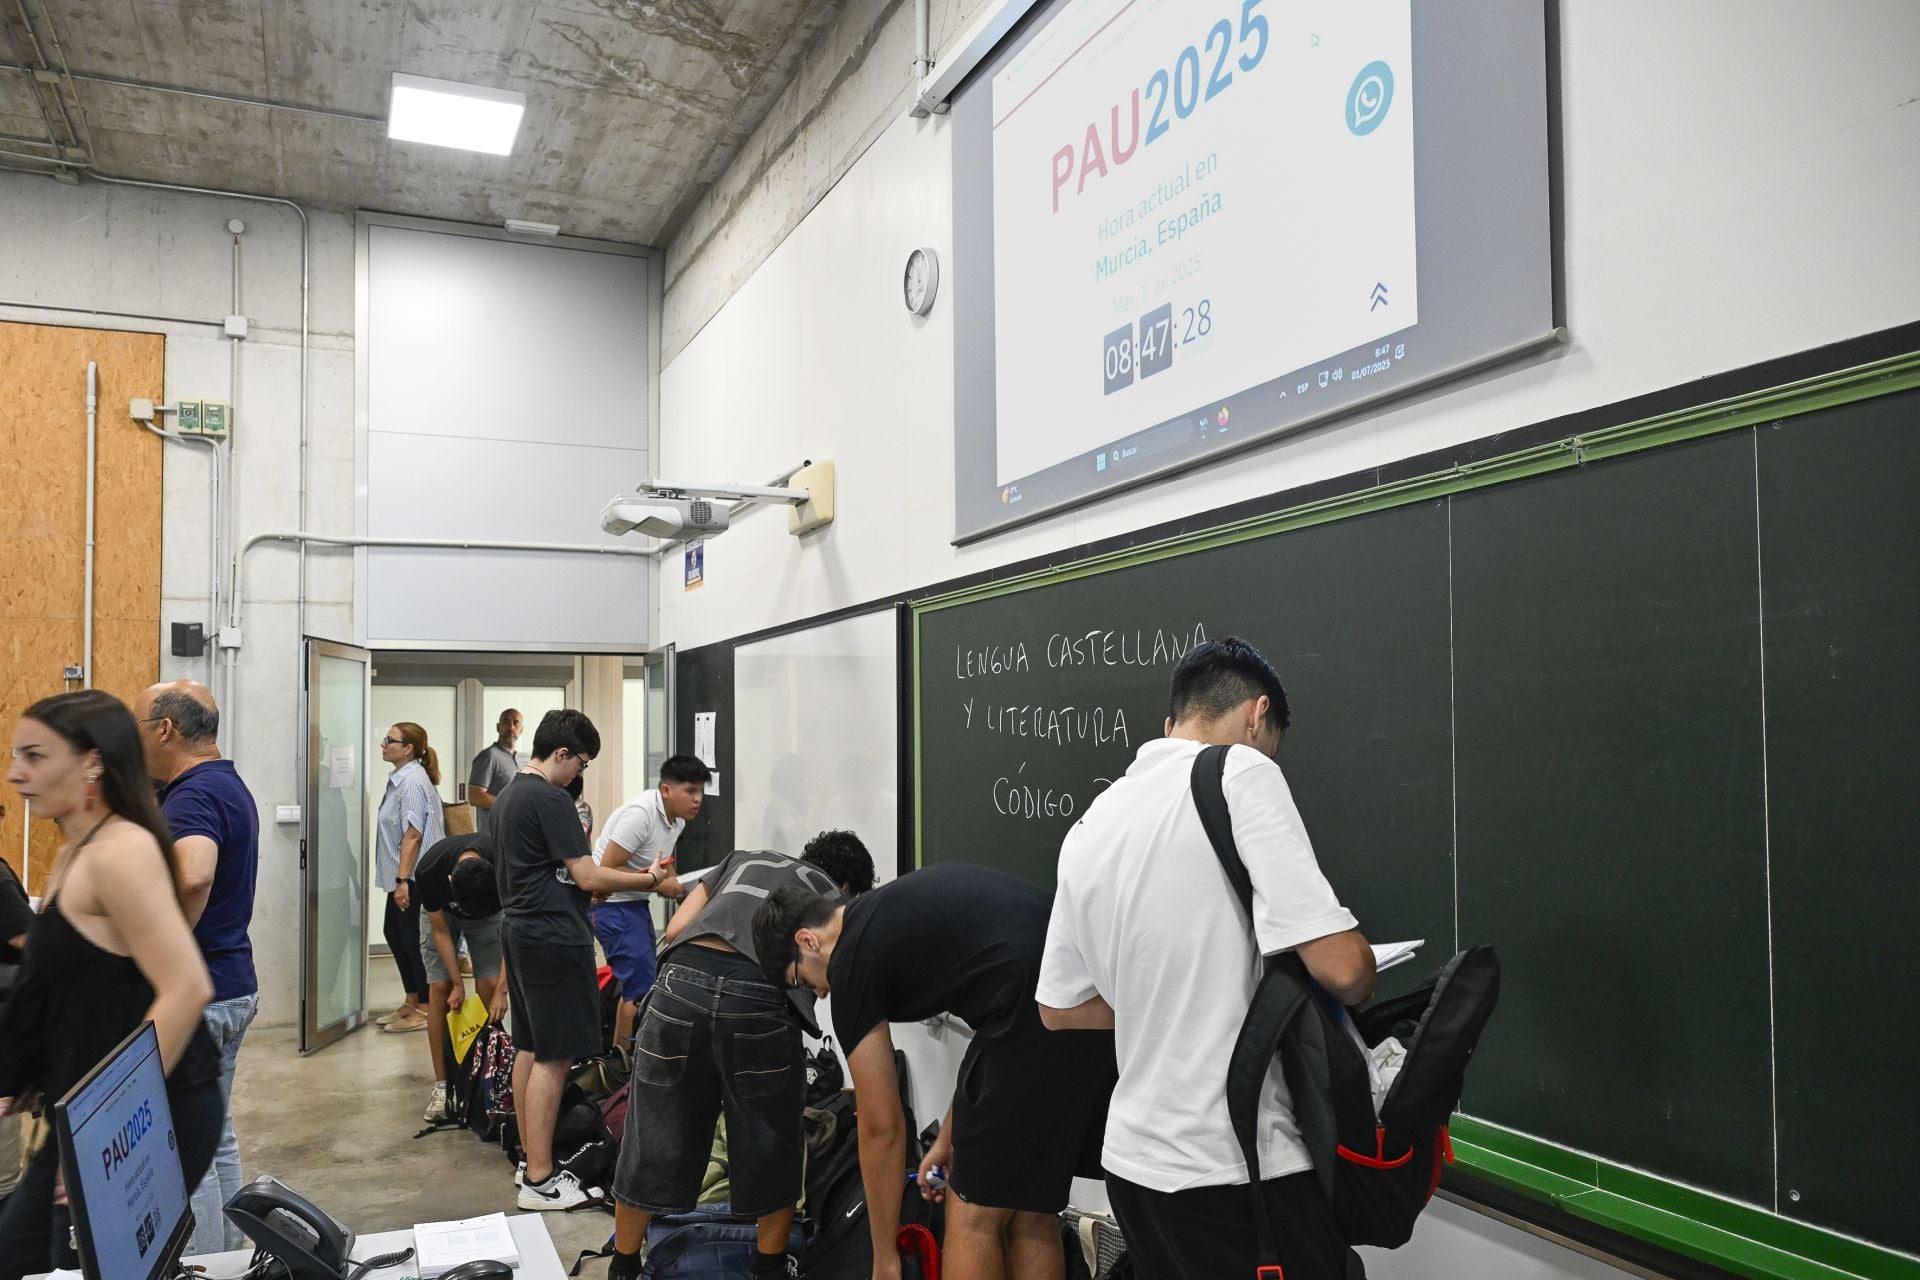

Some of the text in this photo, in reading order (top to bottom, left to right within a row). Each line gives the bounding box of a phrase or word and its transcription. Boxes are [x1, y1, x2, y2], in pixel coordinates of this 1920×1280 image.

[1052, 0, 1269, 214] PAU2025
[1098, 152, 1217, 244] Hora actual en
[1095, 192, 1223, 283] Murcia, España
[1351, 359, 1391, 381] 01/07/2025
[1374, 344, 1390, 358] 8:47
[1297, 382, 1309, 395] ESP
[956, 622, 1207, 680] LENGUA CASTELLANA
[963, 697, 1129, 748] Y LITERATURA
[993, 761, 1074, 819] CÓDIGO
[102, 1099, 153, 1181] PAU2025
